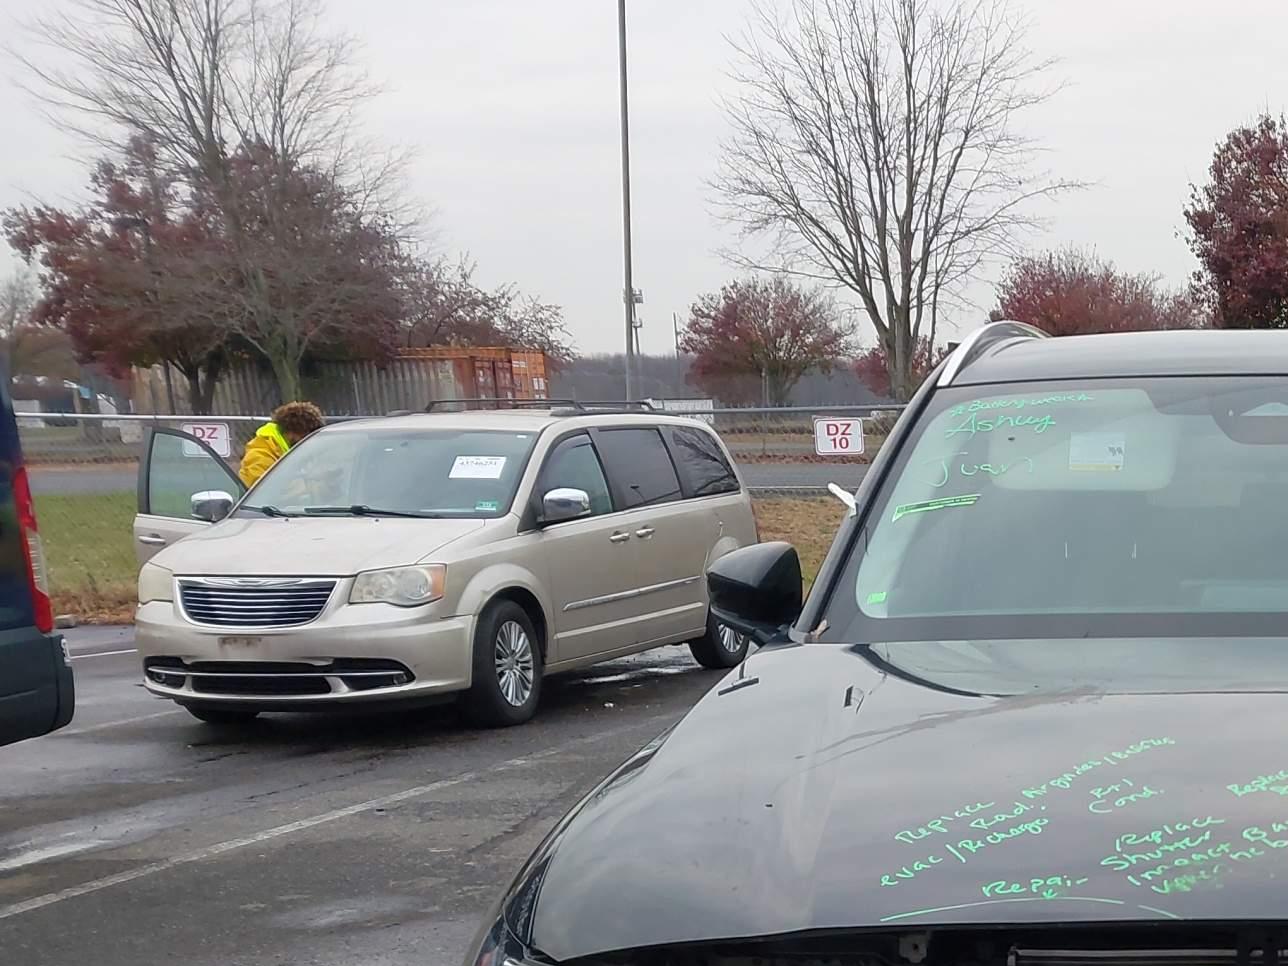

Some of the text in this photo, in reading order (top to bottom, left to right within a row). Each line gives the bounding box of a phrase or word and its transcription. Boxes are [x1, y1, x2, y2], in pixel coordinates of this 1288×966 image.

[192, 426, 219, 440] DZ
[826, 423, 852, 436] DZ
[830, 436, 849, 450] 10
